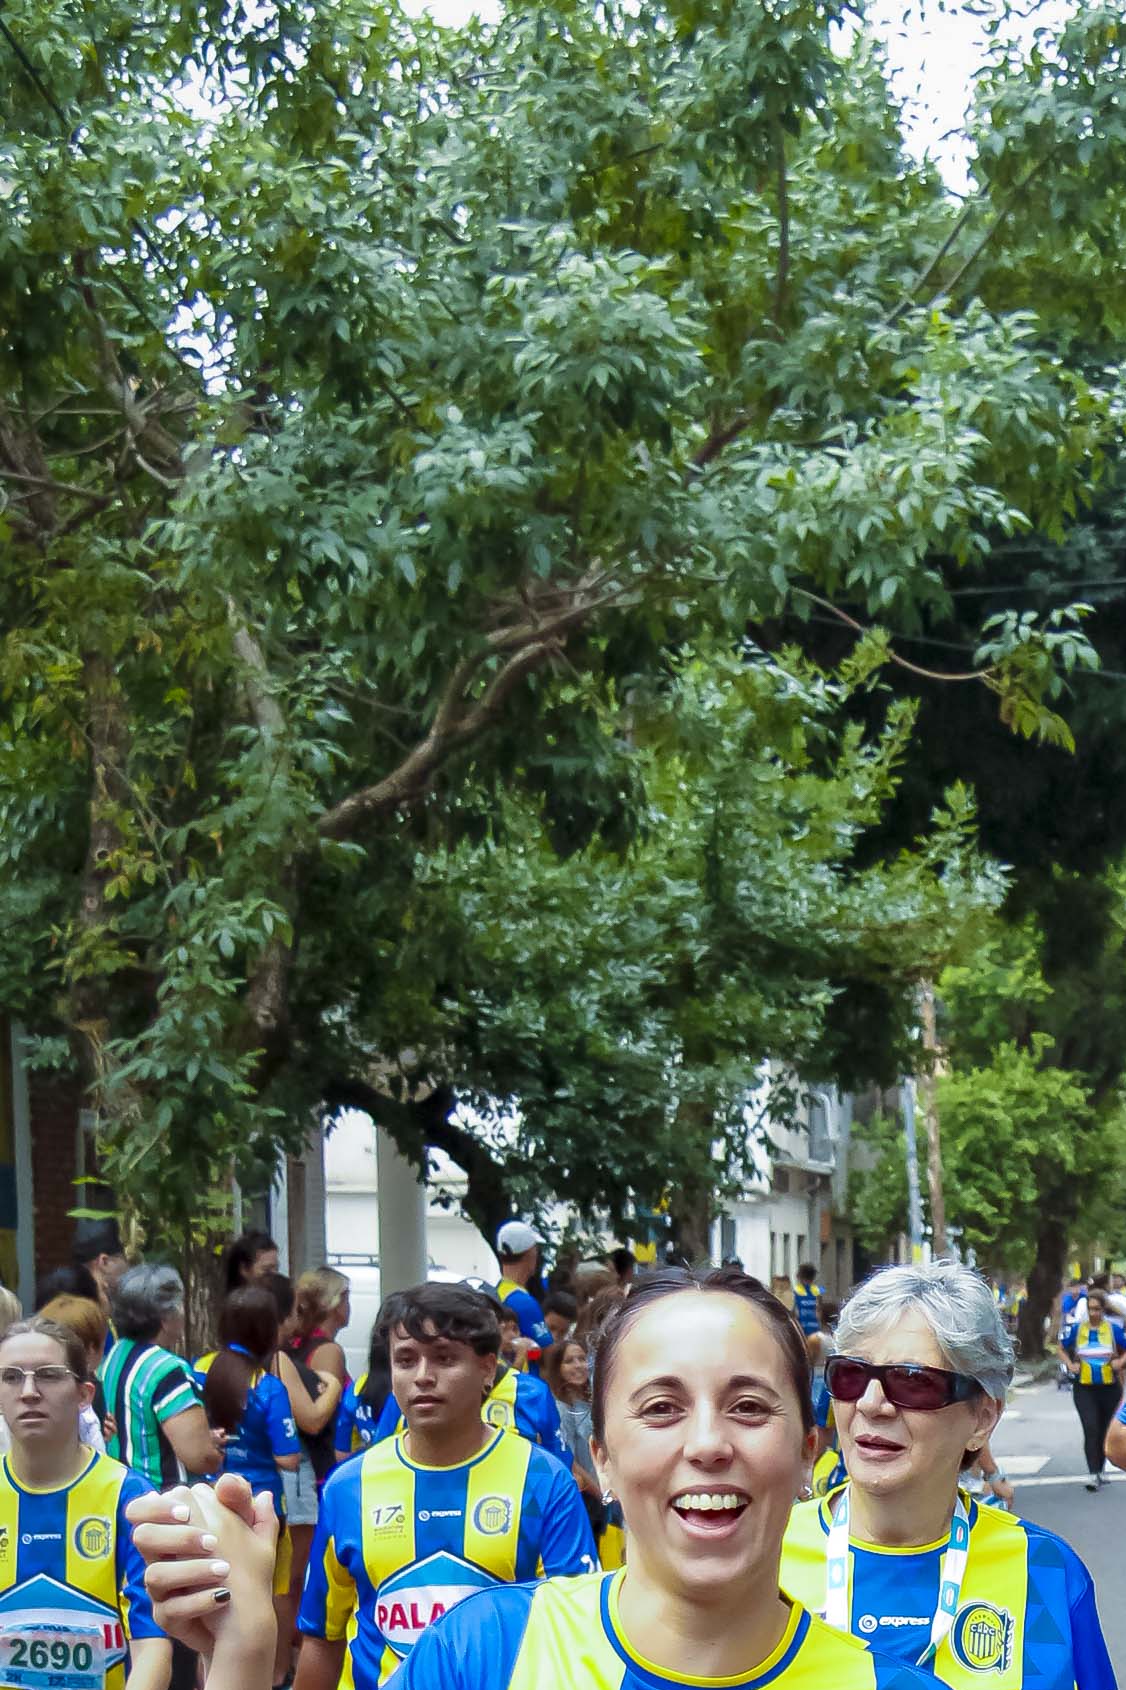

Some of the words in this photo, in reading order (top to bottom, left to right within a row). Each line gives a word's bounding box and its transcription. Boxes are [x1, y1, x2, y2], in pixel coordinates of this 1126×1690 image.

[377, 1602, 447, 1632] PALA
[878, 1615, 931, 1628] express
[10, 1638, 93, 1672] 2690
